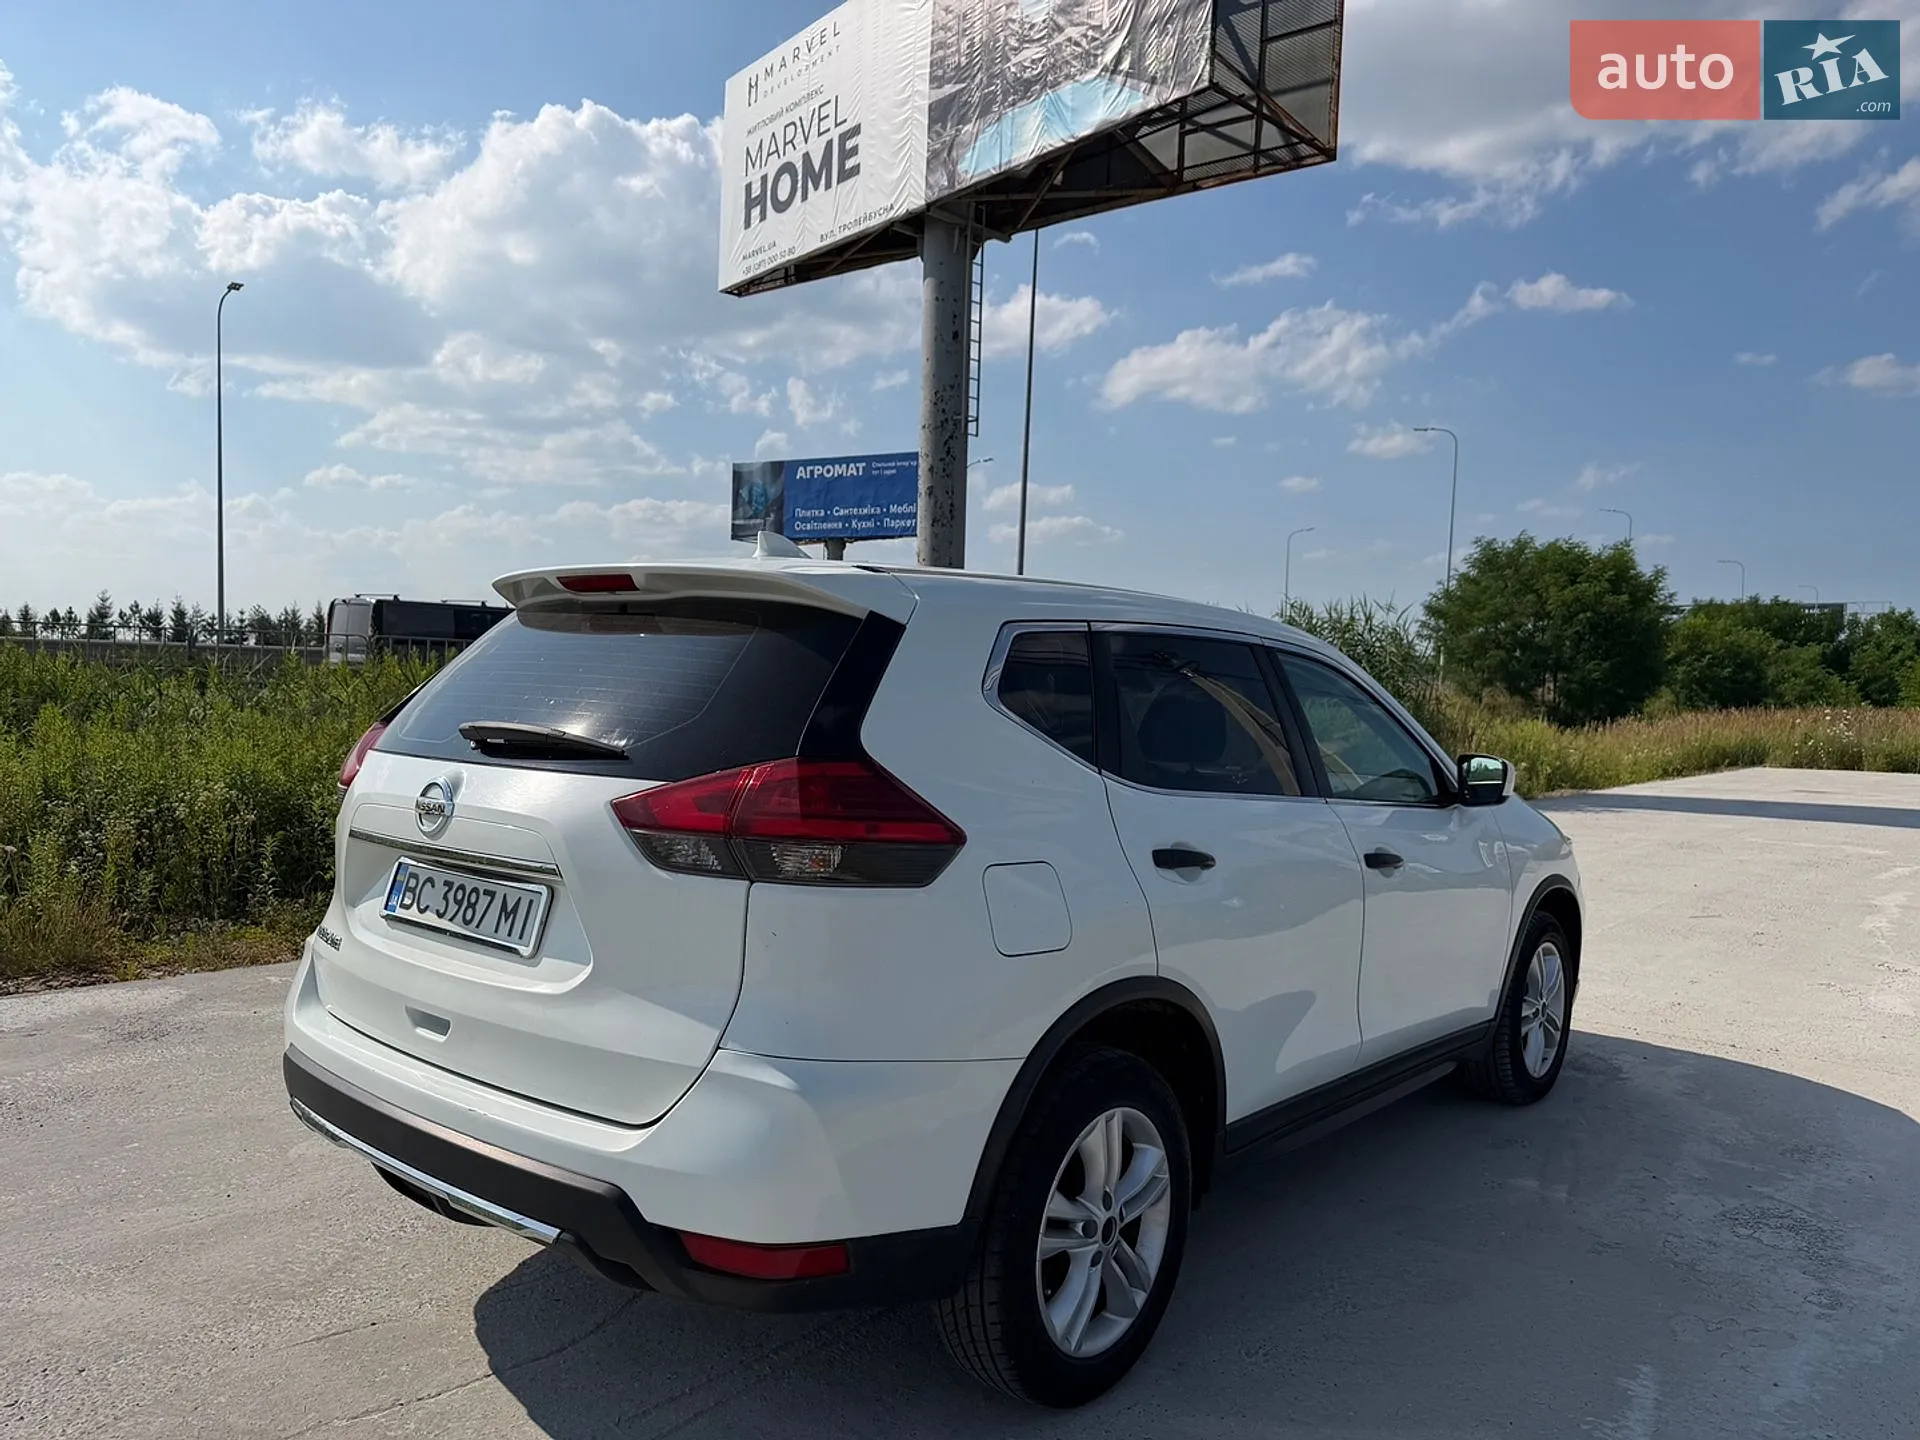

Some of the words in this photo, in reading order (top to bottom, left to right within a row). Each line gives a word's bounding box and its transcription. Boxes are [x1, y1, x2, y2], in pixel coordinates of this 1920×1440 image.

[763, 21, 840, 82] MARVEL
[744, 94, 847, 177] MARVEL
[744, 122, 861, 230] HOME
[796, 462, 867, 480] АГРОМАТ
[795, 508, 825, 517] Плитка
[833, 505, 881, 516] Сантехніка
[399, 872, 436, 914] BC
[435, 880, 498, 929] 3987
[493, 893, 534, 940] MI
